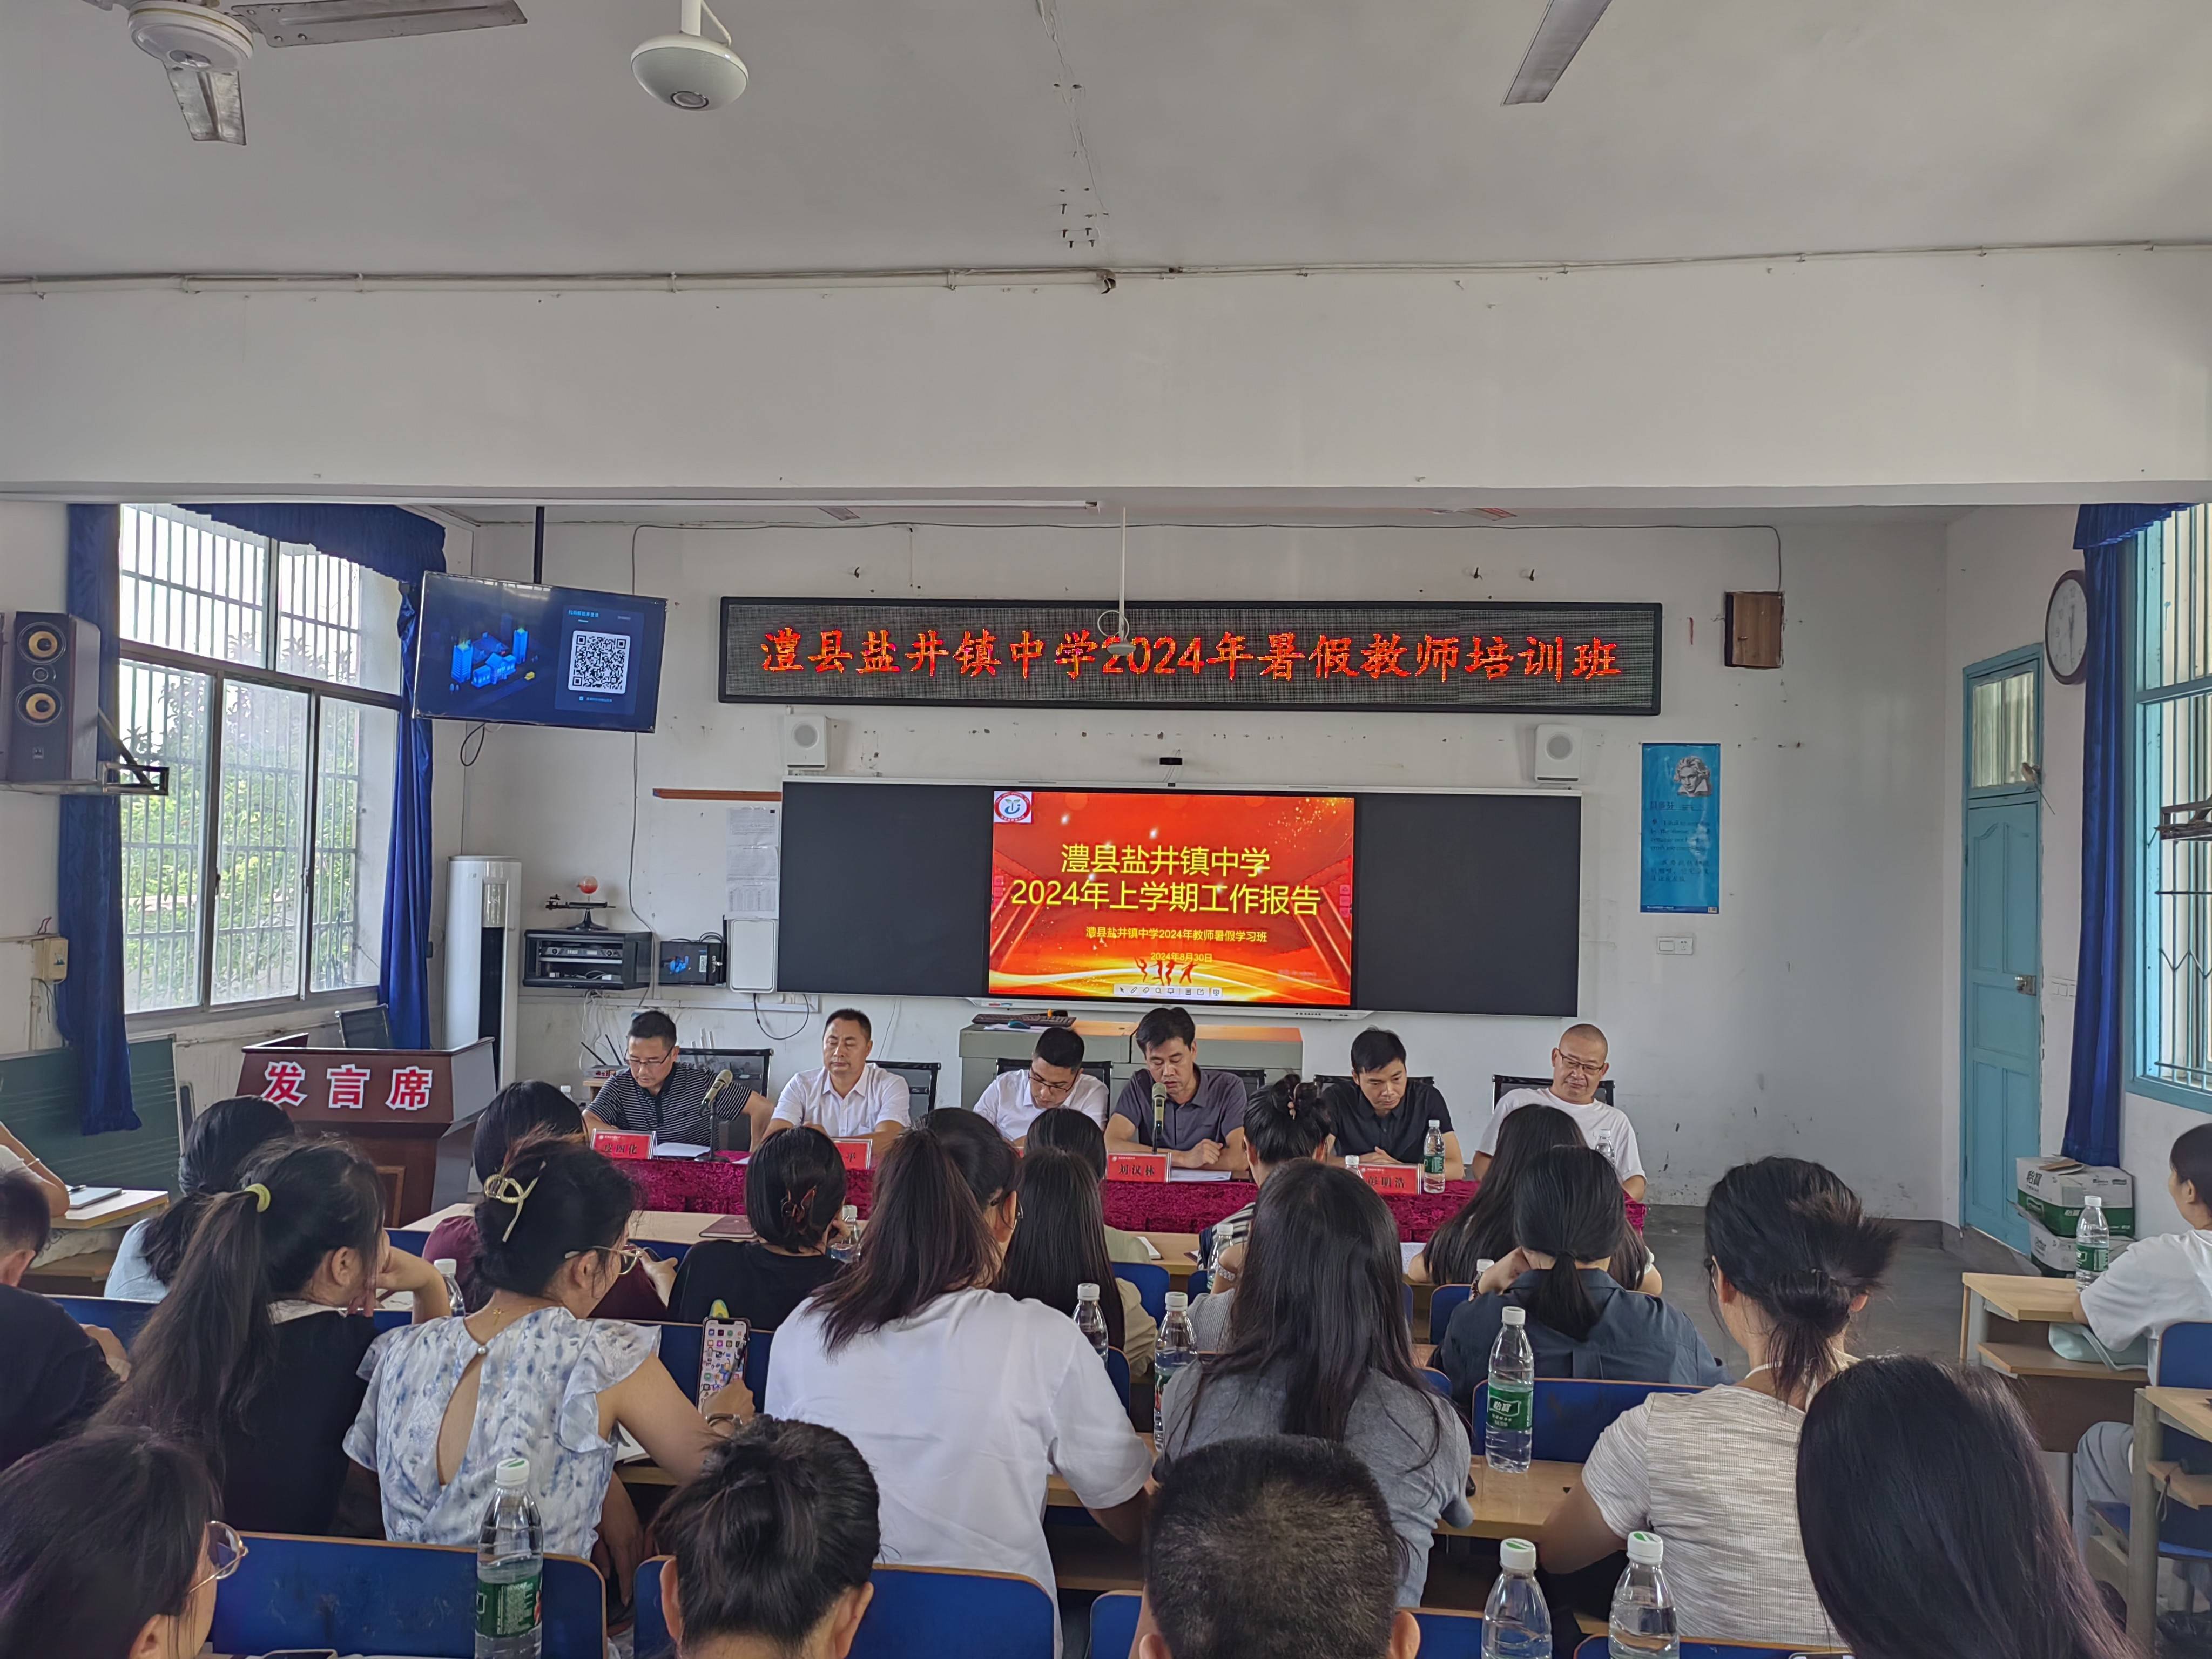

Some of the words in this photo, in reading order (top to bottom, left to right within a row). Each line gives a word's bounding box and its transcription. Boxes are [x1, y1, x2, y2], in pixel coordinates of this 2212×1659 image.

[760, 626, 1621, 683] 澧县盐井镇中学2024年暑假教师培训班
[1061, 842, 1270, 878] 澧县盐井镇中学
[1011, 880, 1321, 916] 2024年上学期工作报告
[1085, 926, 1267, 943] 澧县盐井镇中学2024年教师暑假学习班
[1150, 952, 1212, 963] 2024年8月30日
[260, 1061, 432, 1111] 发言席
